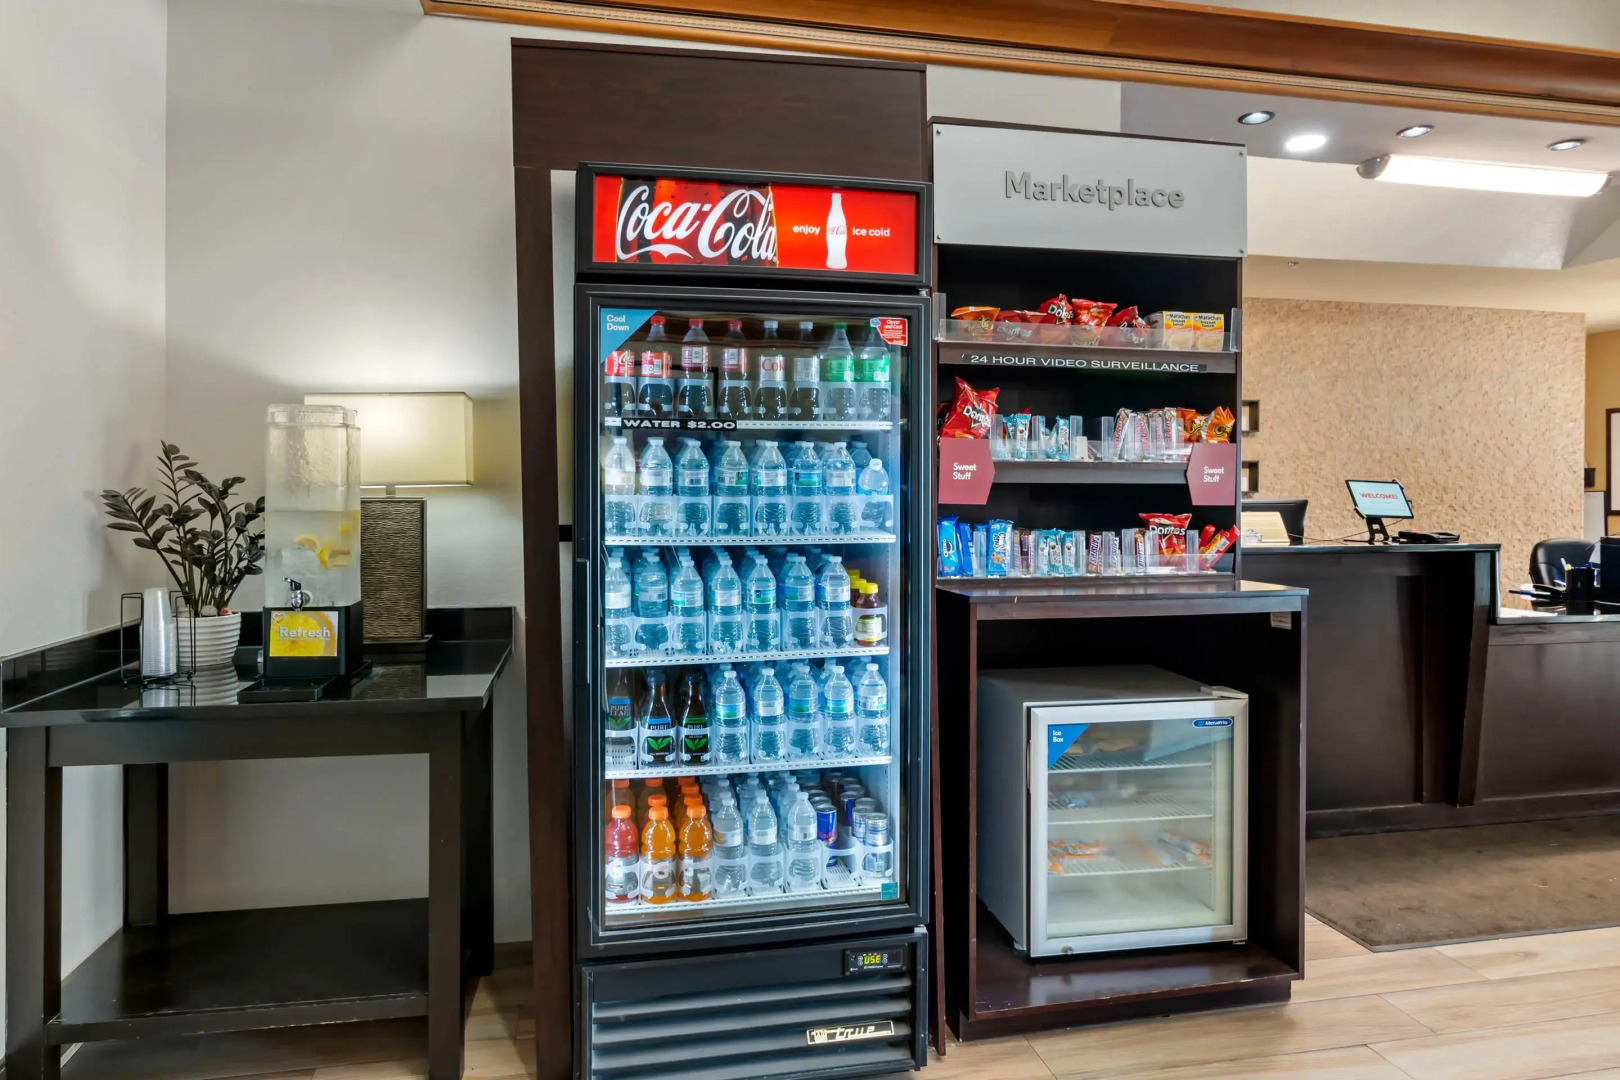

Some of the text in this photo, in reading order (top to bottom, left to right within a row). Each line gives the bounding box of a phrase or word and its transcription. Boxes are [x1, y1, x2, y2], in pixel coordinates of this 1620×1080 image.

[1005, 170, 1185, 211] Marketplace
[616, 185, 776, 261] Coca-Cola
[792, 224, 821, 236] enjoy
[852, 226, 867, 236] ice
[868, 228, 891, 237] cold
[606, 314, 626, 323] Cool
[606, 323, 630, 331] Down
[970, 355, 1199, 372] 24 HOUR VIDEO SURVEILLANCE
[623, 420, 735, 430] WATER $2.00
[953, 462, 977, 471] Sweet
[1203, 466, 1225, 474] Sweet
[953, 471, 971, 480] Stuff
[1203, 475, 1220, 483] Stuff
[1150, 525, 1186, 536] Doritos
[279, 627, 331, 638] Refresh
